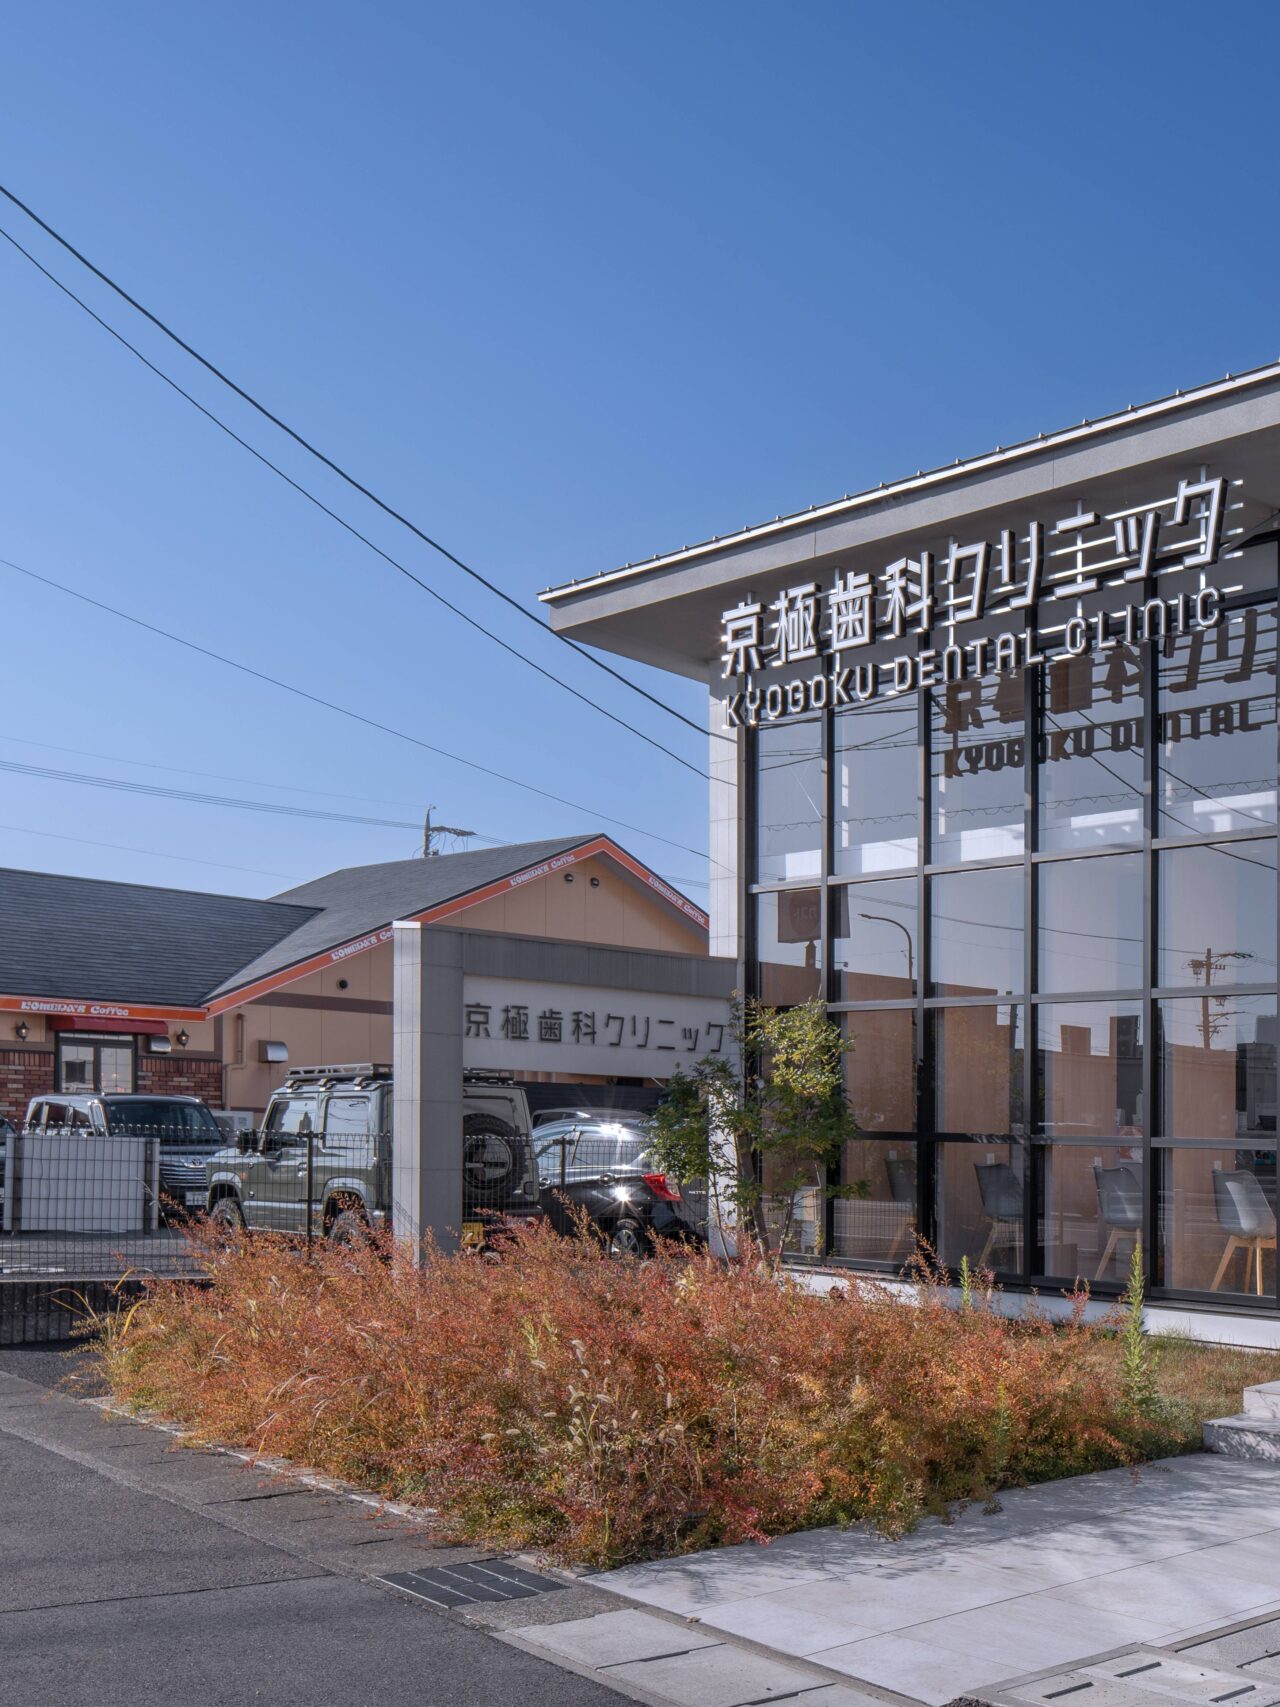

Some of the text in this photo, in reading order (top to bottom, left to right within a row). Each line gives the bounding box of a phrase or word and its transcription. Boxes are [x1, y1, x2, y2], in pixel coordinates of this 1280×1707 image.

[722, 477, 1228, 676] 京極歯科クリニック
[726, 662, 880, 728] KYOGOKU
[893, 627, 1045, 693] DENTAL
[1065, 585, 1227, 656] CLINIC
[90, 1006, 129, 1017] Coffee
[464, 1002, 727, 1053] 京極歯科クリニック
